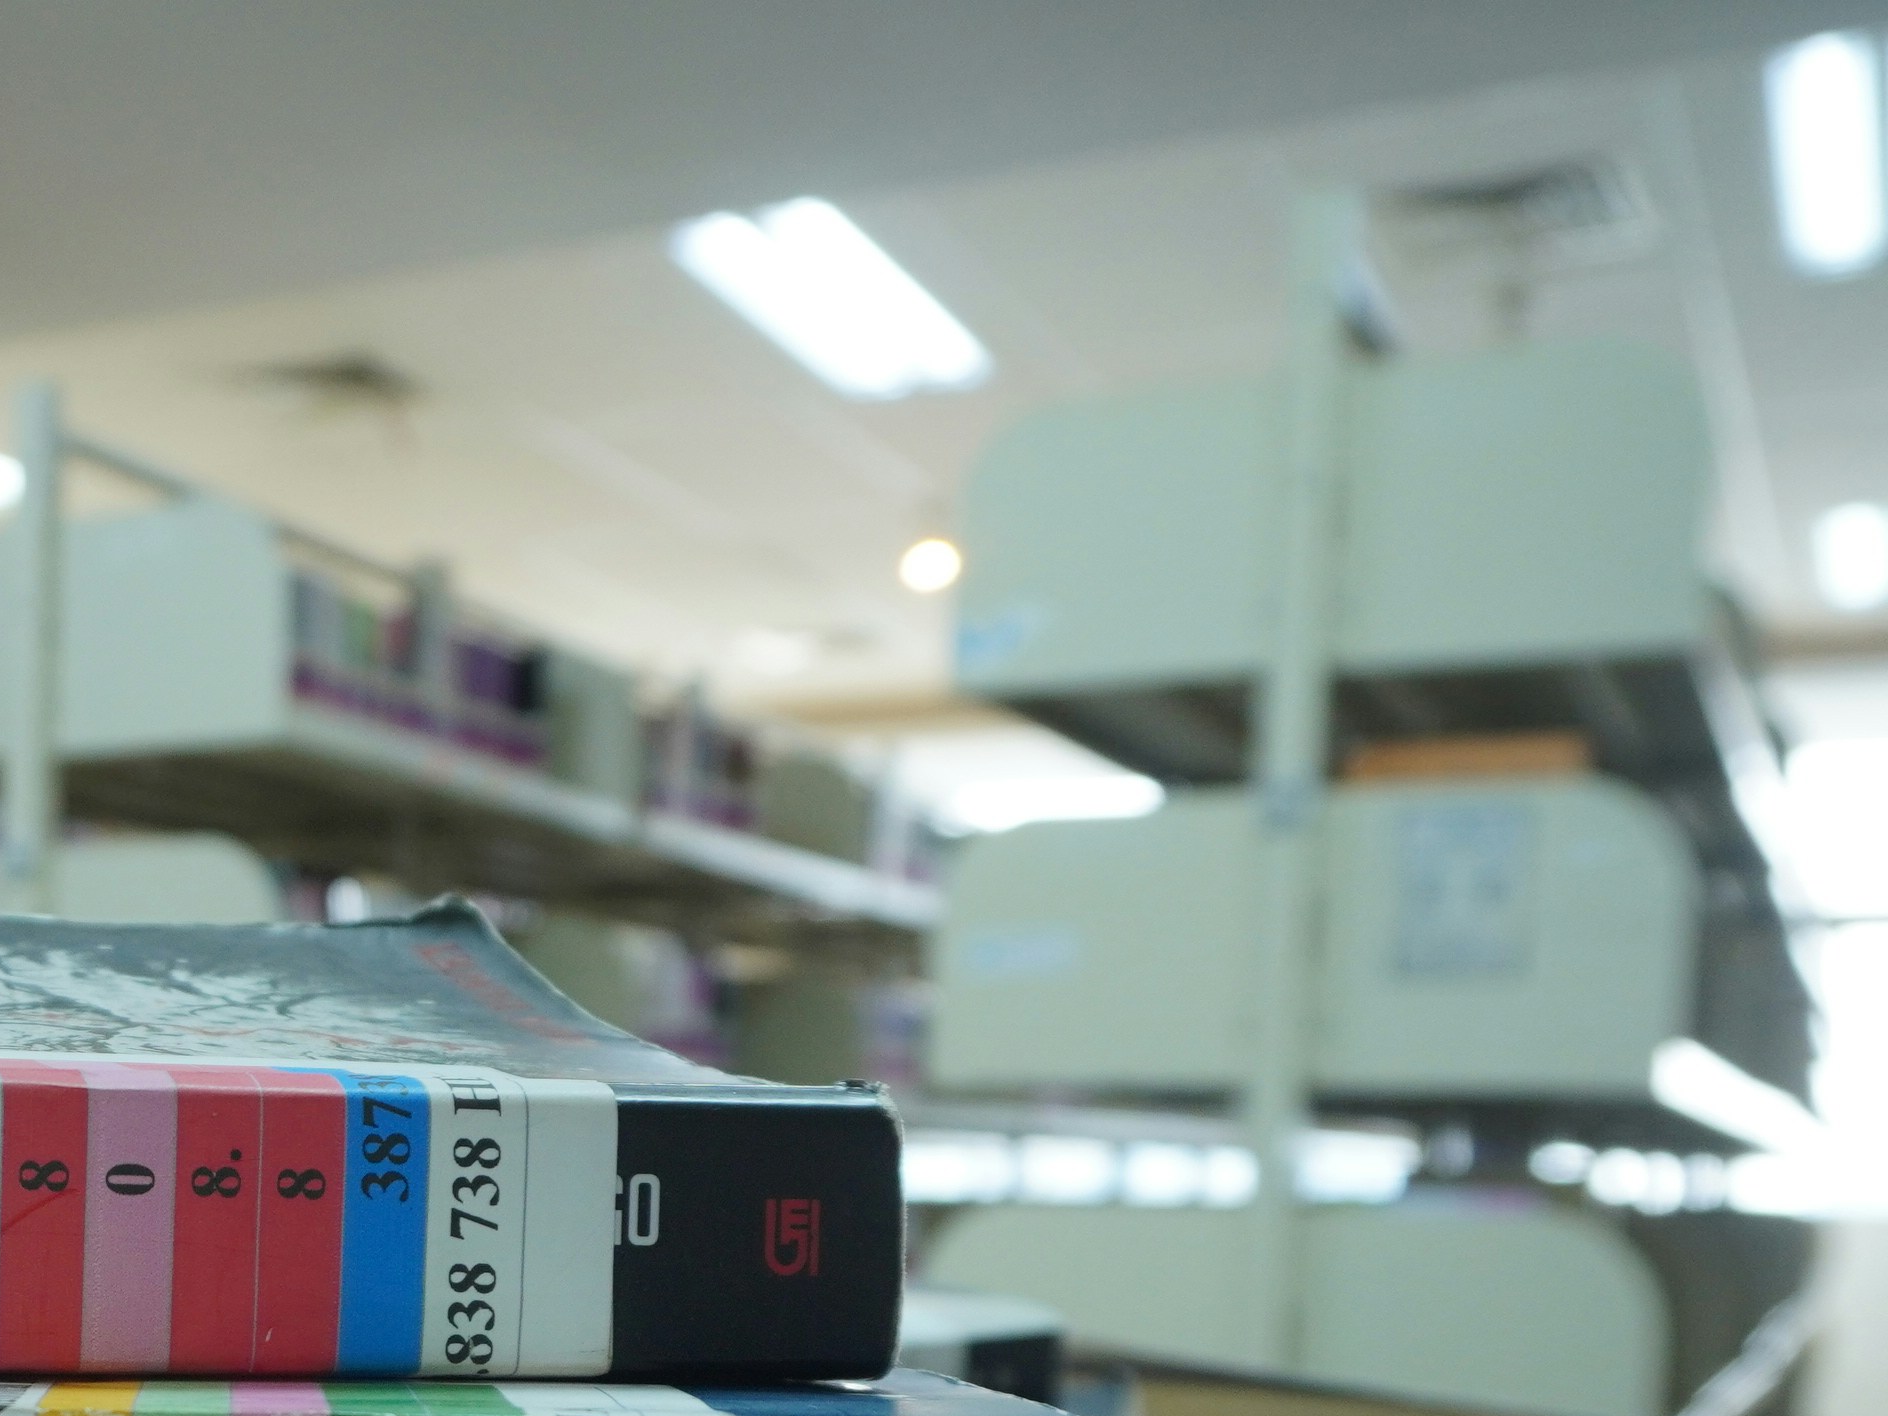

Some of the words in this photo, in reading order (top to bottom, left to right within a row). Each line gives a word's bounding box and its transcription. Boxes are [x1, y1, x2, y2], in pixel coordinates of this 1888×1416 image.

[432, 1075, 502, 1117] H
[18, 1160, 70, 1192] 8
[105, 1163, 155, 1196] 0
[191, 1149, 242, 1199] 8.
[276, 1169, 326, 1200] 8
[449, 1137, 502, 1240] 738
